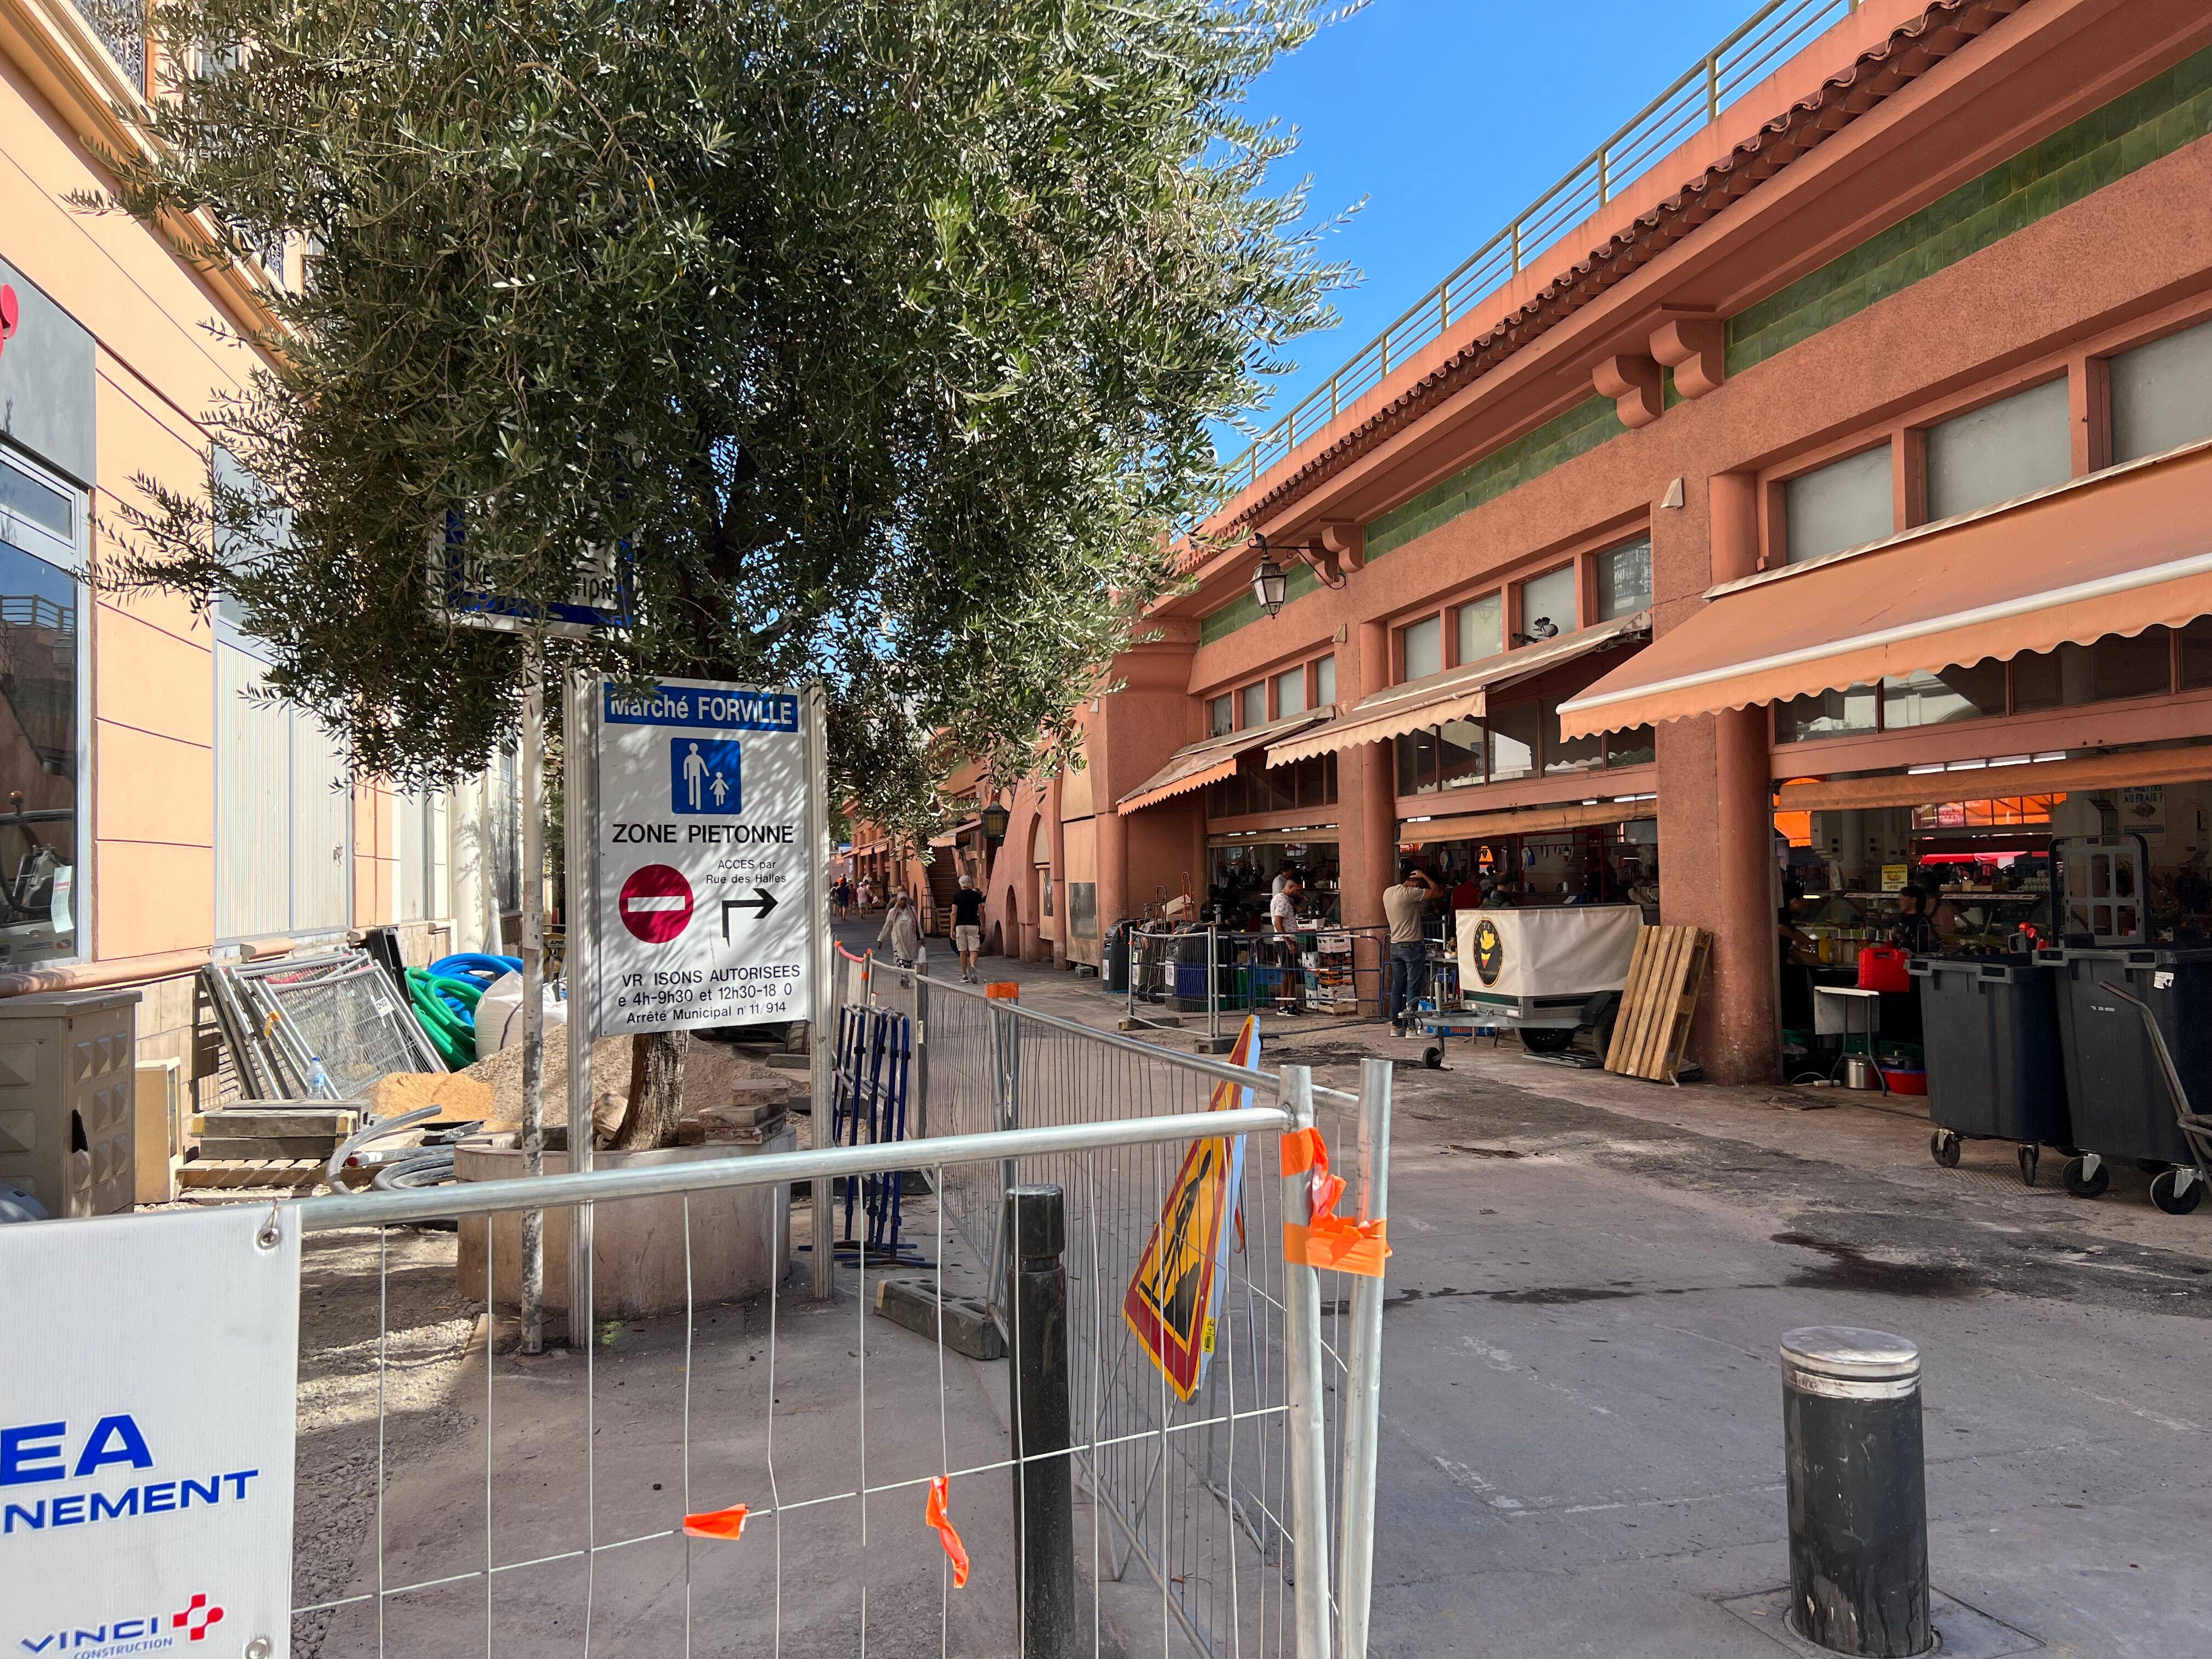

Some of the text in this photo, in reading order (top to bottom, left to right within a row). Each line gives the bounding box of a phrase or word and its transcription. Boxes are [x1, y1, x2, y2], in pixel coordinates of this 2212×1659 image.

[611, 694, 792, 724] Marché FORVILLE
[2124, 793, 2134, 803] AU
[2136, 792, 2157, 803] FRAIS
[612, 823, 793, 843] ZONE PIETONNE
[718, 860, 776, 870] ACCES par
[706, 873, 786, 883] Rue des Halles
[709, 964, 800, 982] AUTORISEES
[633, 989, 693, 1006] 4h-9h30
[699, 989, 712, 1001] et
[627, 1011, 667, 1024] Arrêté
[673, 1005, 731, 1020] Municipal
[749, 1001, 786, 1014] 11/914
[0, 1414, 154, 1486] EA
[4, 1469, 259, 1534] NEMENT
[20, 1616, 159, 1654] VINCI
[74, 1637, 173, 1659] CONSTRUCTION
